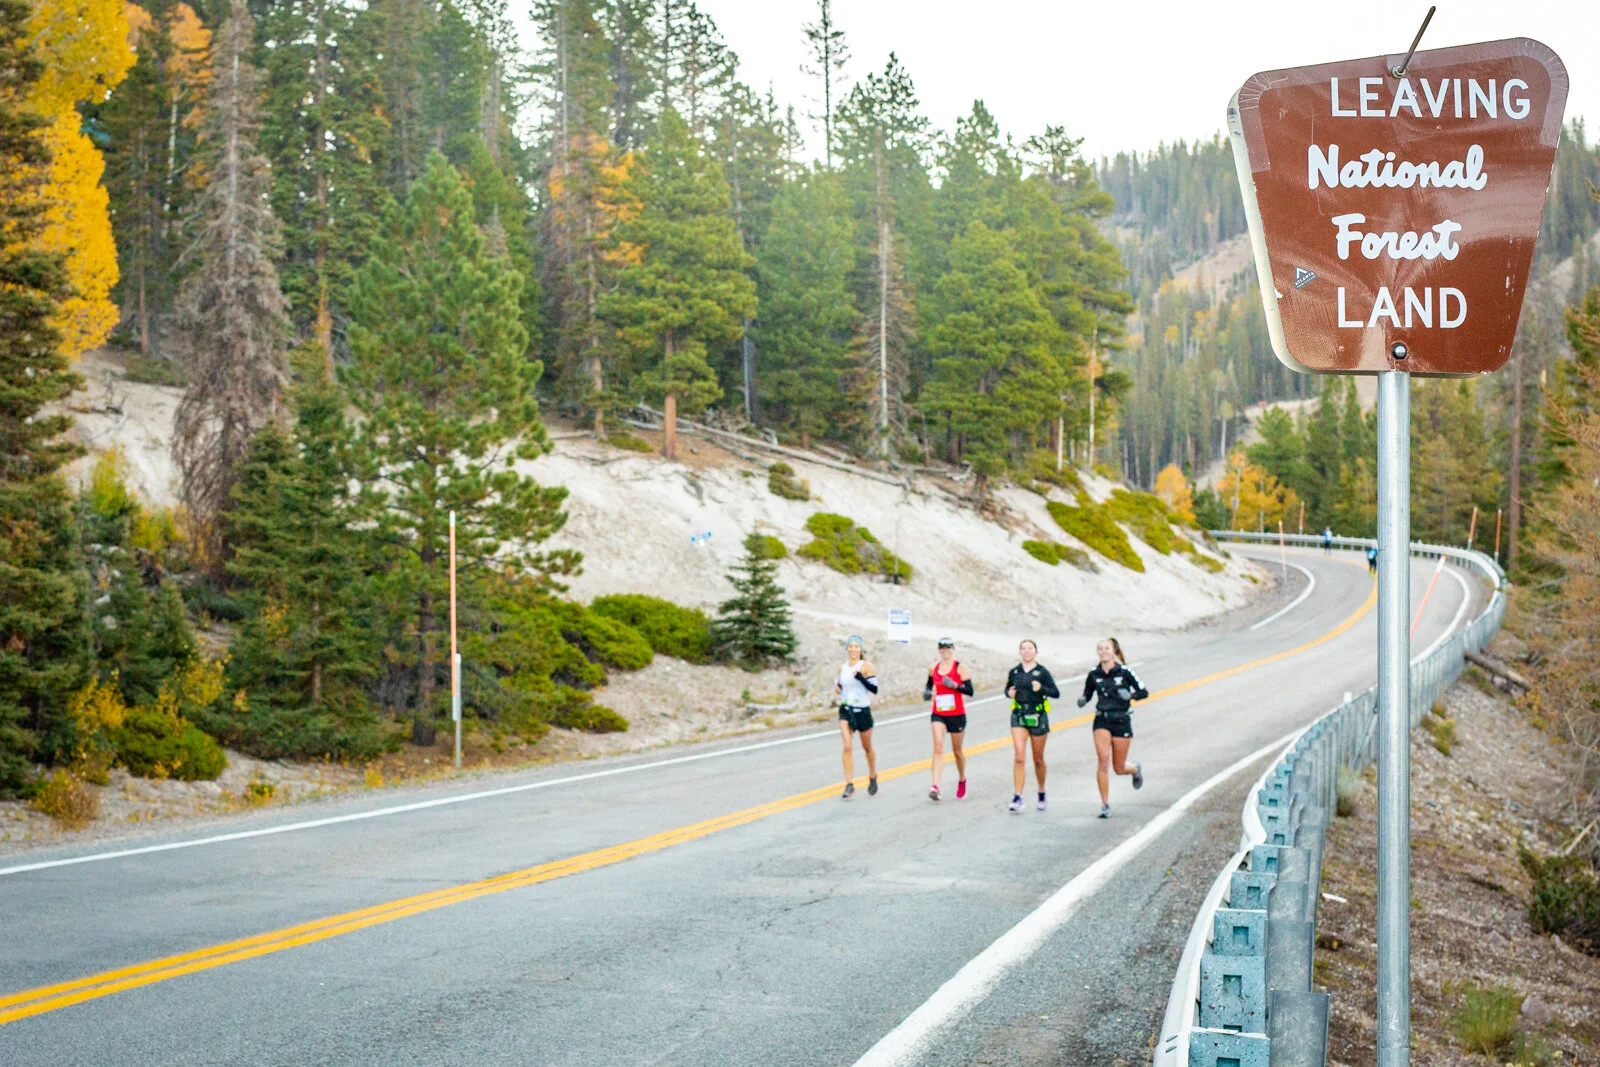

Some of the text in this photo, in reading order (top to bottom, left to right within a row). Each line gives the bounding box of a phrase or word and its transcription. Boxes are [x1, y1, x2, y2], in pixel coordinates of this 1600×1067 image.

[1330, 76, 1531, 120] LEAVING
[1307, 143, 1488, 191] National
[1331, 212, 1463, 261] Forest
[1337, 286, 1468, 329] LAND
